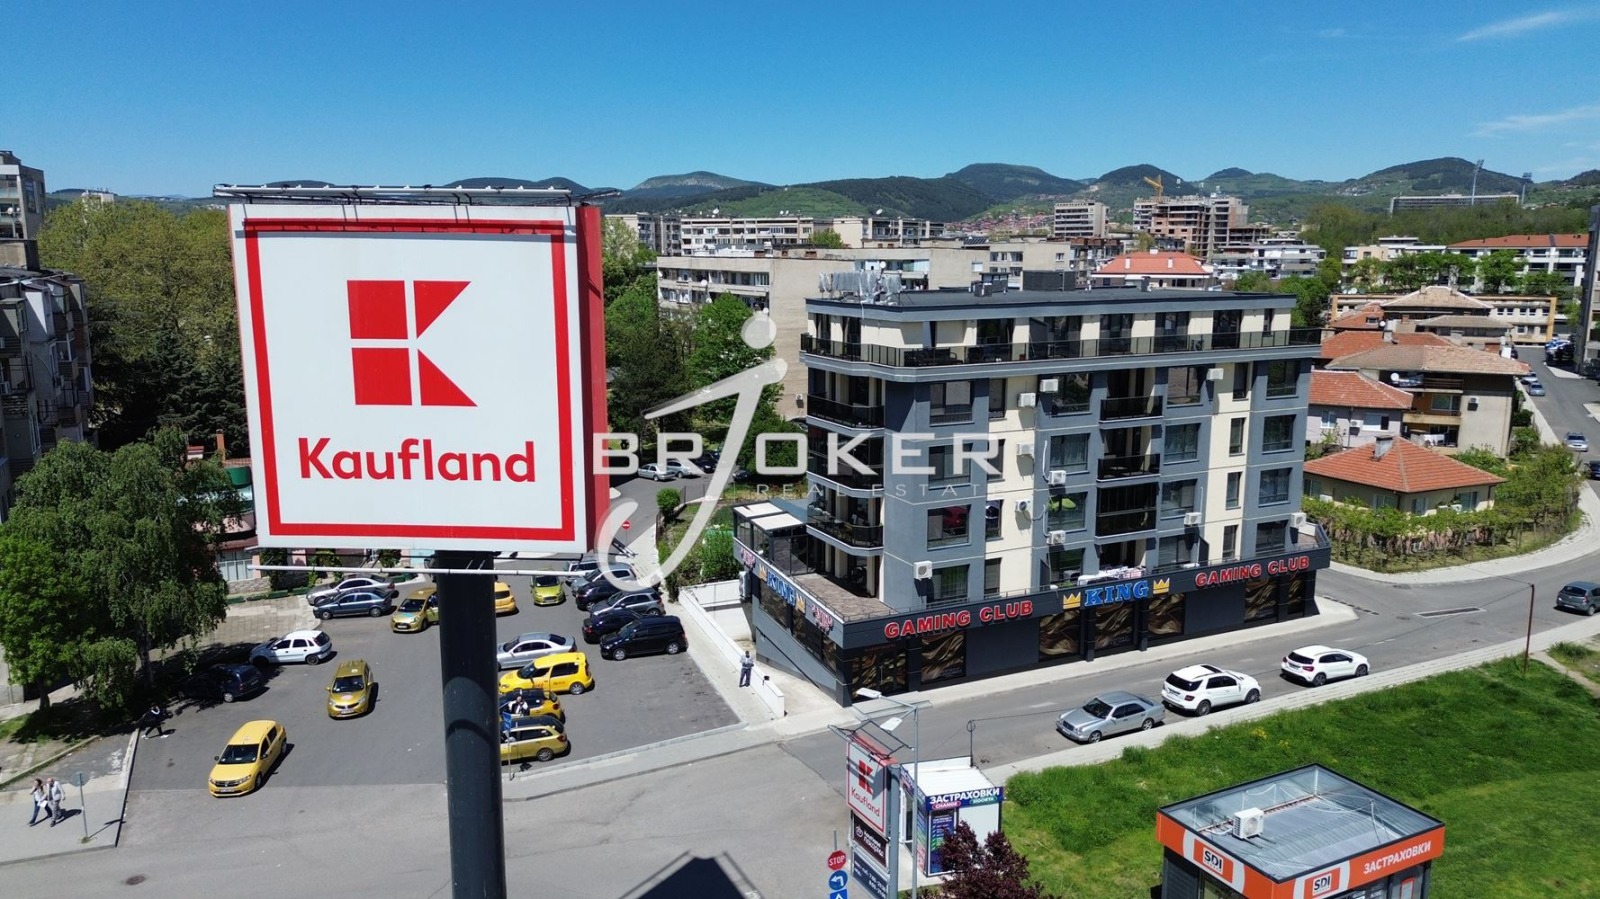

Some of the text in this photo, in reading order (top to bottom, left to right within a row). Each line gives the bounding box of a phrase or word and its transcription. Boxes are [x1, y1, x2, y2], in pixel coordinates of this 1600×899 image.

[298, 437, 536, 483] Kaufland
[1195, 555, 1310, 588] GAMING CLUB
[1084, 580, 1149, 607] KING
[884, 600, 1033, 639] GAMING CLUB
[851, 786, 880, 817] Kaufland
[929, 787, 1000, 805] ЗАСТРАХОВКИ
[935, 801, 958, 809] CHANGE
[829, 855, 846, 867] STOP
[1204, 850, 1222, 870] SDI
[1363, 841, 1431, 875] ЗАСТРАХОВКИ
[1313, 876, 1331, 892] SDI
